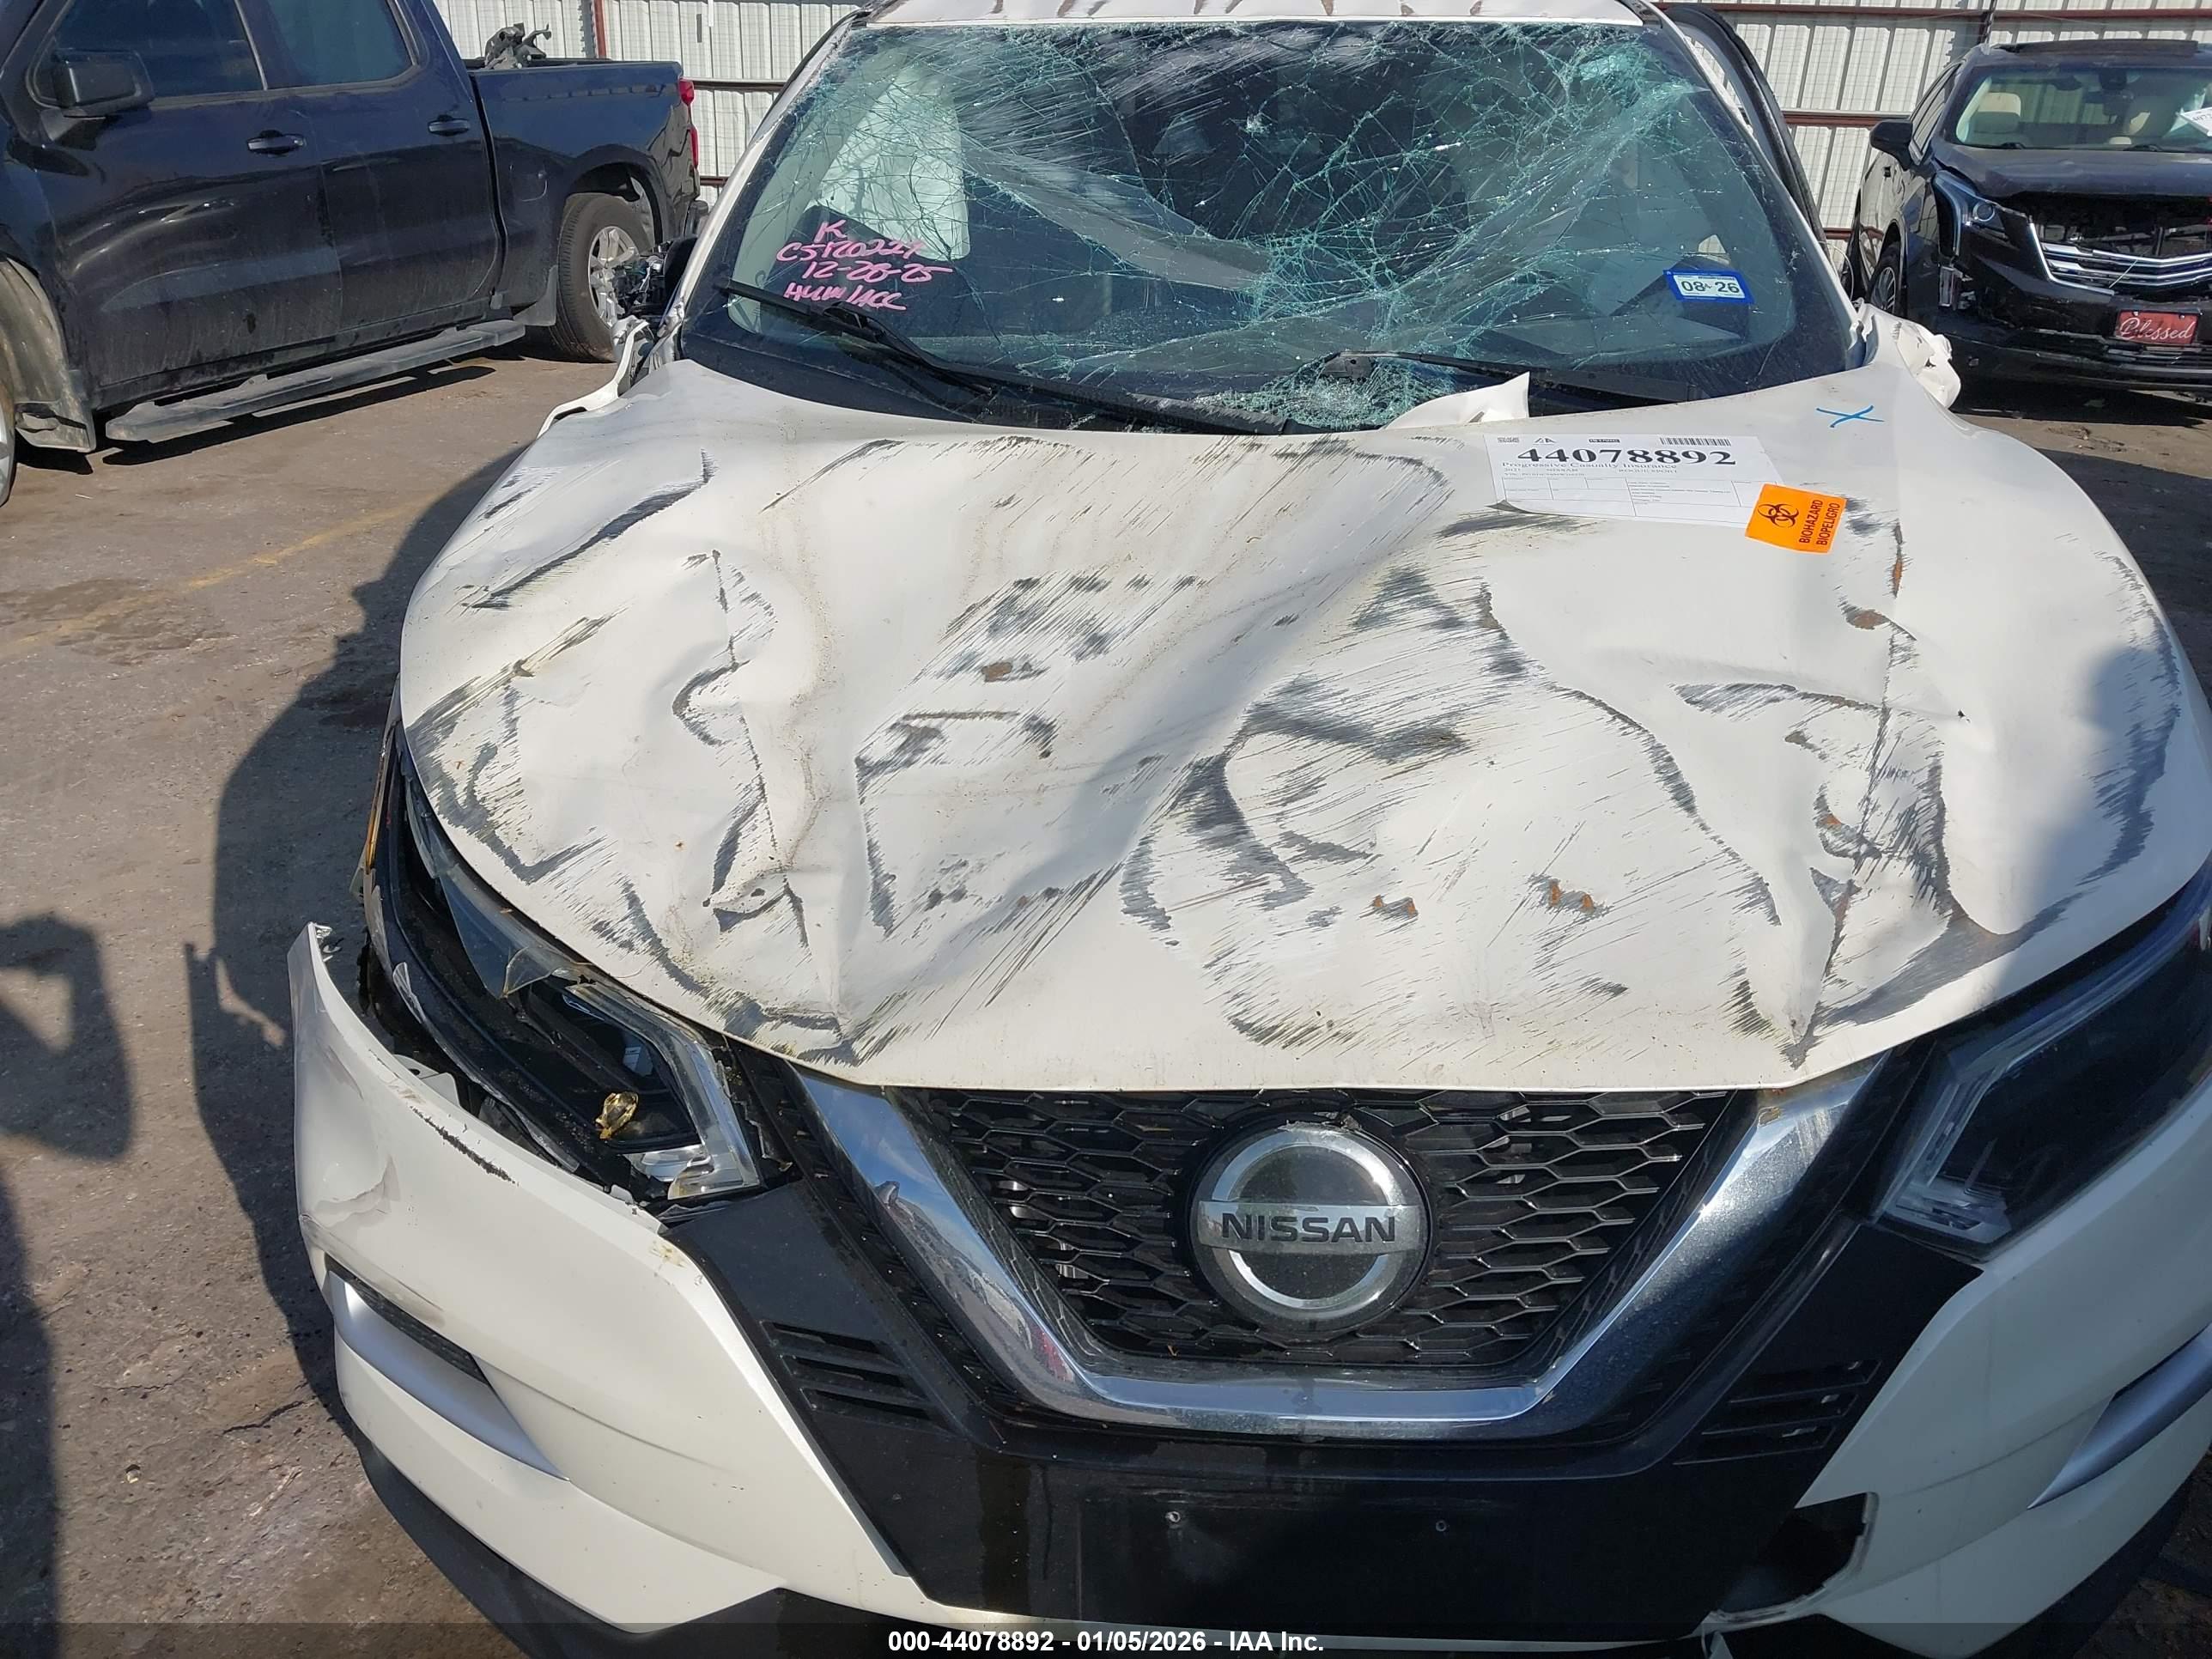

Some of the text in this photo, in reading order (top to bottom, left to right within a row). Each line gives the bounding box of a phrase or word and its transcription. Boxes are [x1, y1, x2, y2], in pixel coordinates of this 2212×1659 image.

[813, 219, 848, 243] K
[1680, 280, 1741, 294] 08 26
[2115, 317, 2197, 341] Blessed
[1517, 448, 1736, 465] 44078892
[1799, 500, 1823, 544] BIOHAZARD
[1816, 502, 1840, 545] BIOPELIGRO
[1222, 1212, 1395, 1243] NISSAN
